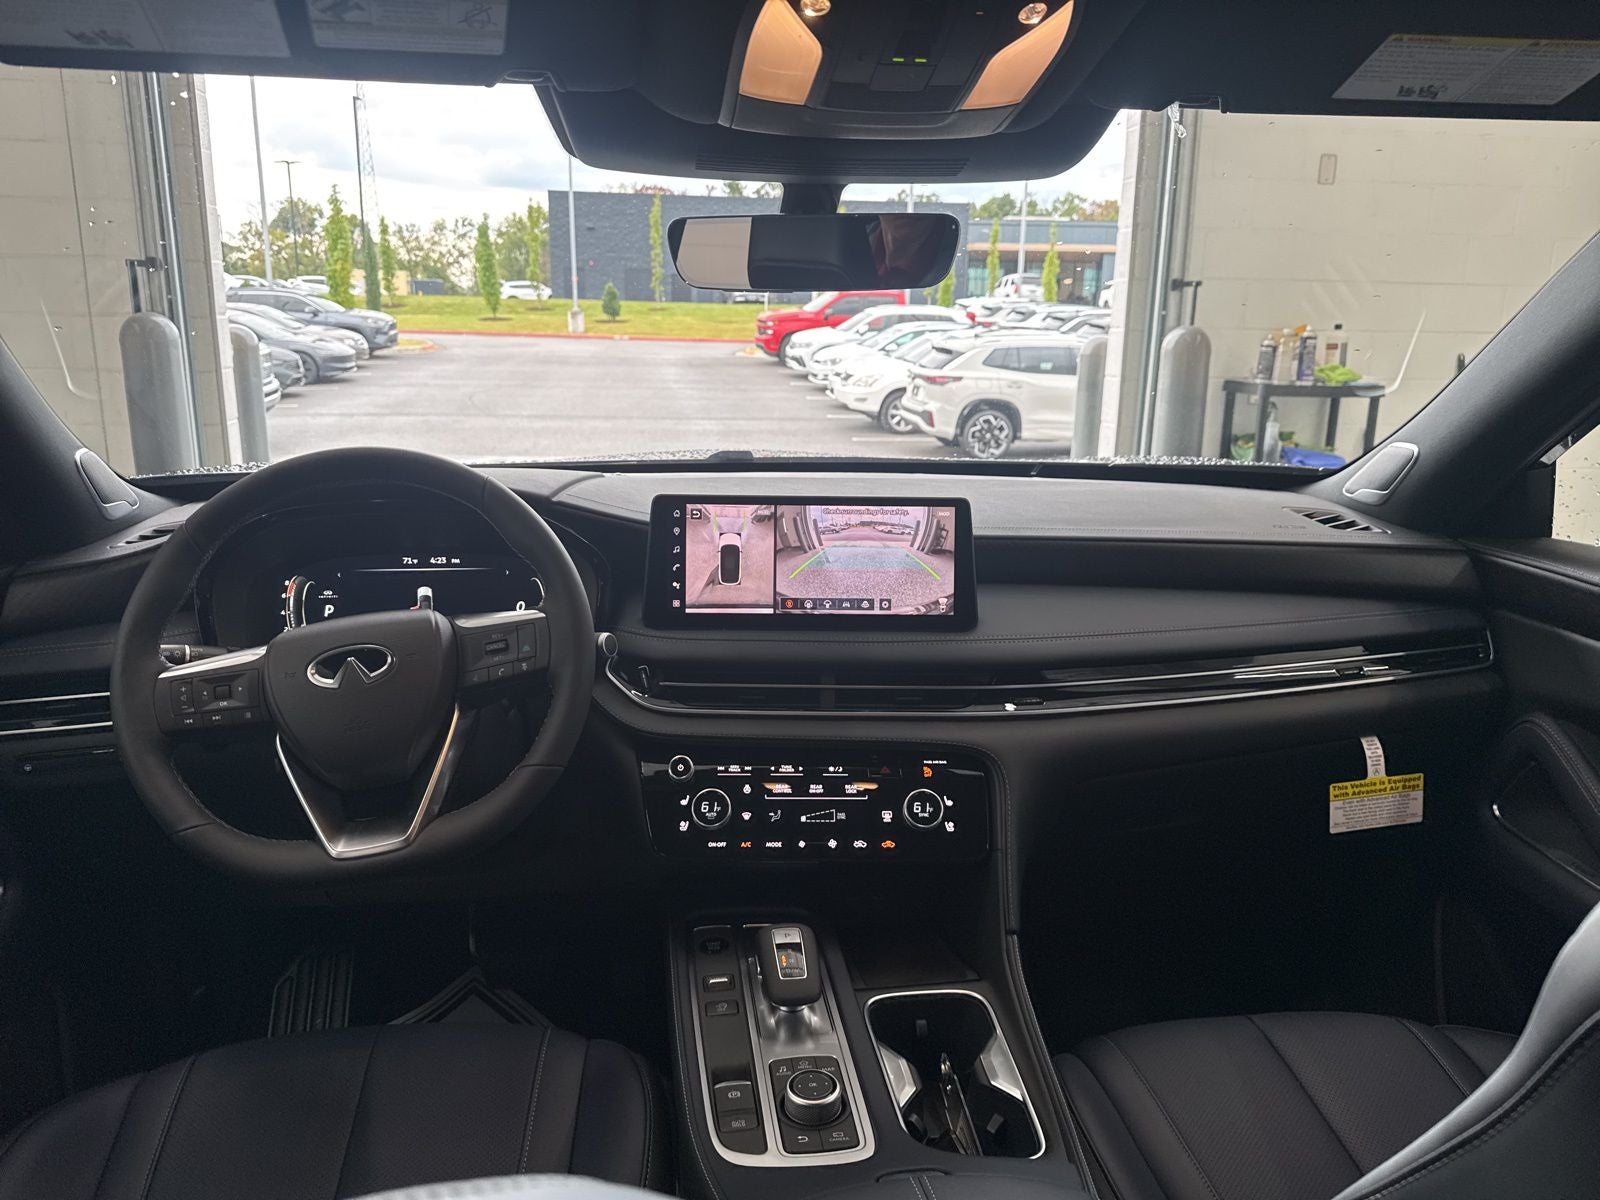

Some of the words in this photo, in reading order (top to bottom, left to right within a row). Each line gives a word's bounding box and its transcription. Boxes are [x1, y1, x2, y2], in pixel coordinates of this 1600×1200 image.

[324, 604, 335, 618] P
[1388, 775, 1421, 784] Equipped
[1351, 786, 1387, 795] Advanced
